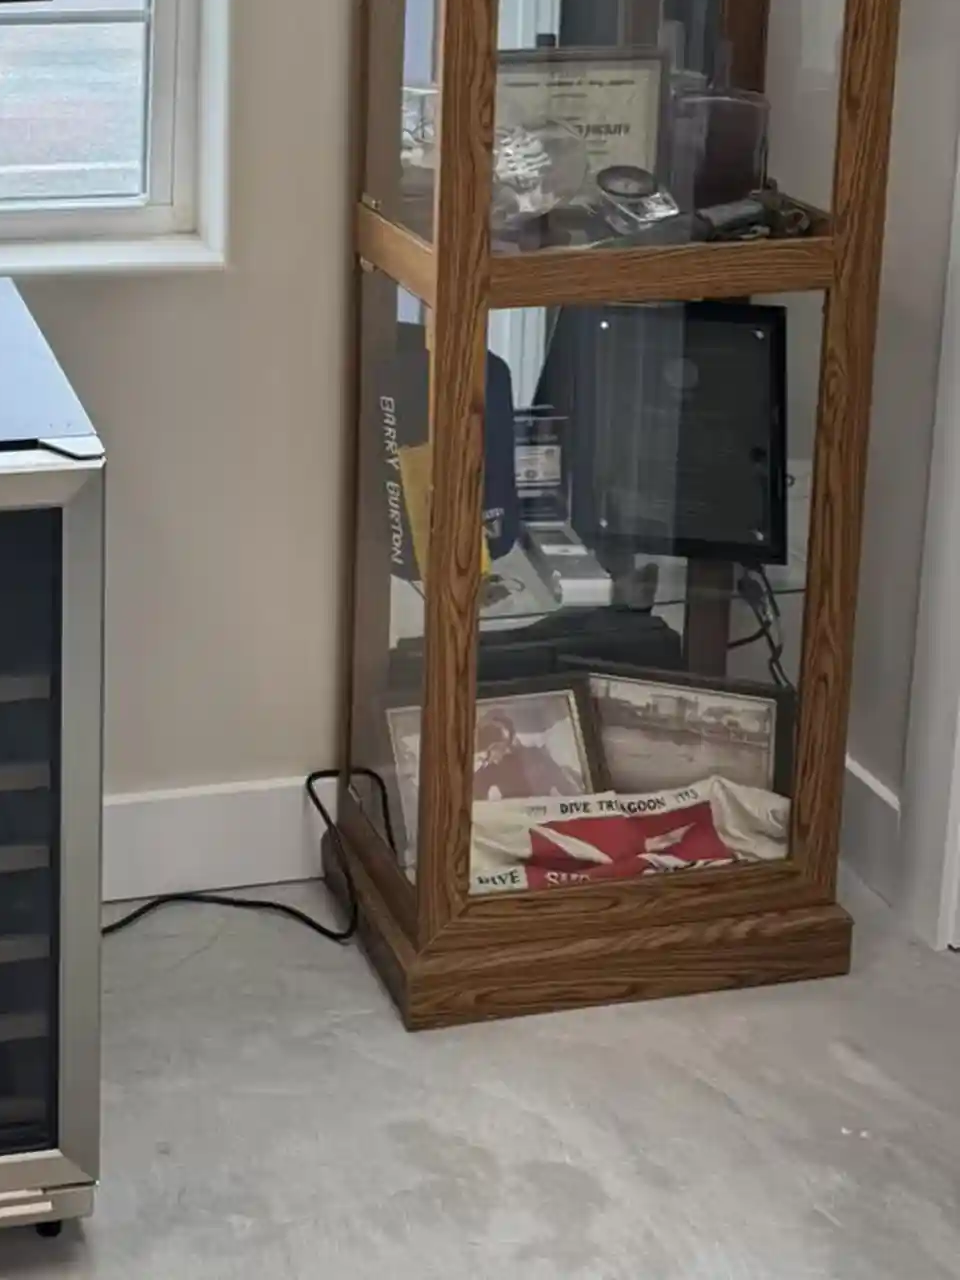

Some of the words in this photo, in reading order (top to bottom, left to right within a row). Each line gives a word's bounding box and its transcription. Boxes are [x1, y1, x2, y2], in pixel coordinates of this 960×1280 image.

[380, 395, 400, 471] BARRY
[386, 481, 404, 565] BURTON
[559, 801, 592, 815] DIVE
